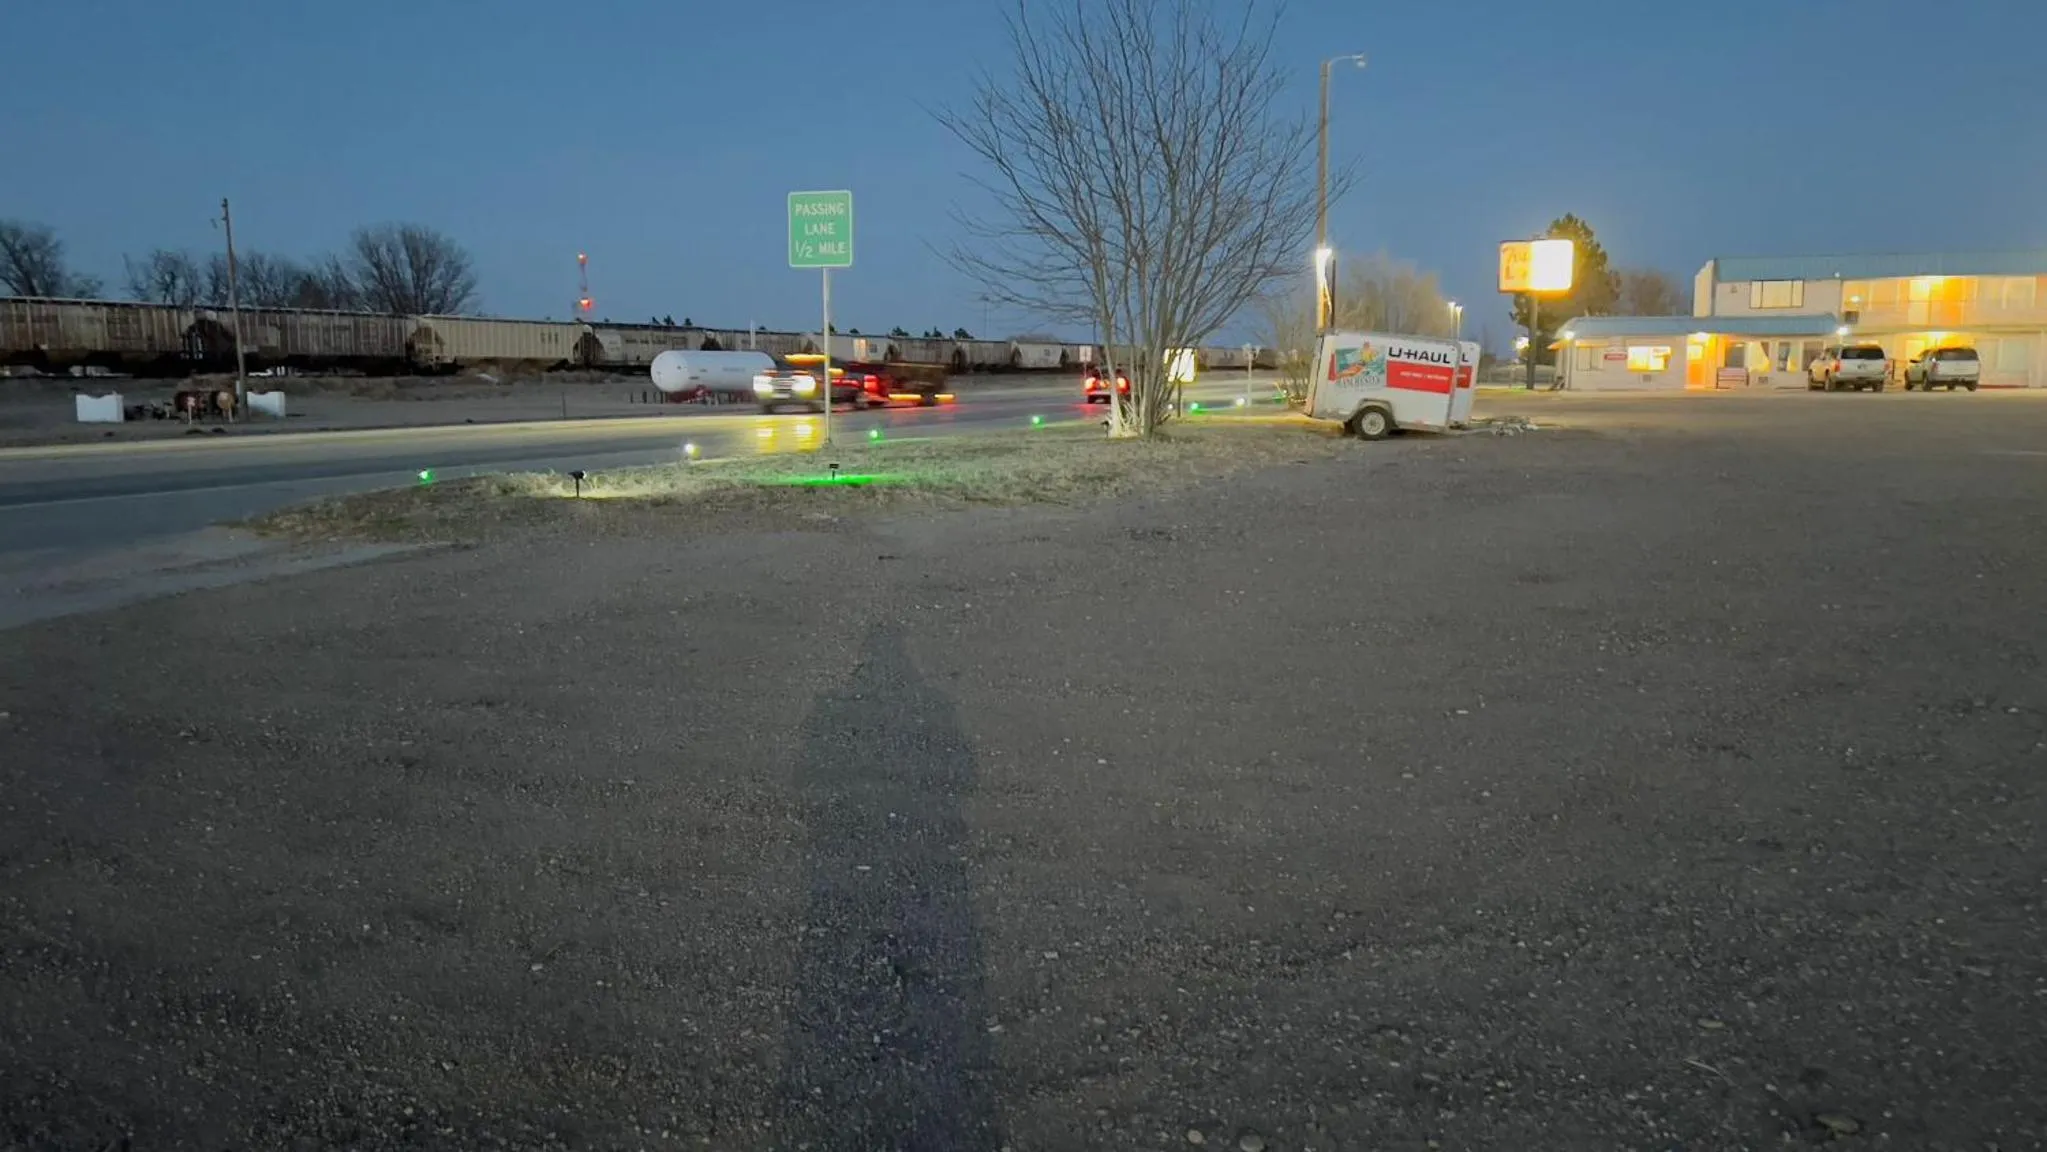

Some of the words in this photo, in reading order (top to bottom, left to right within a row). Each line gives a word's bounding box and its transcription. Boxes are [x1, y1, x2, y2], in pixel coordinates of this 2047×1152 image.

[795, 202, 844, 216] PASSING
[804, 220, 836, 235] LANE
[795, 240, 813, 258] 1/2
[819, 240, 846, 254] MILE
[1388, 346, 1452, 364] U-HAUL
